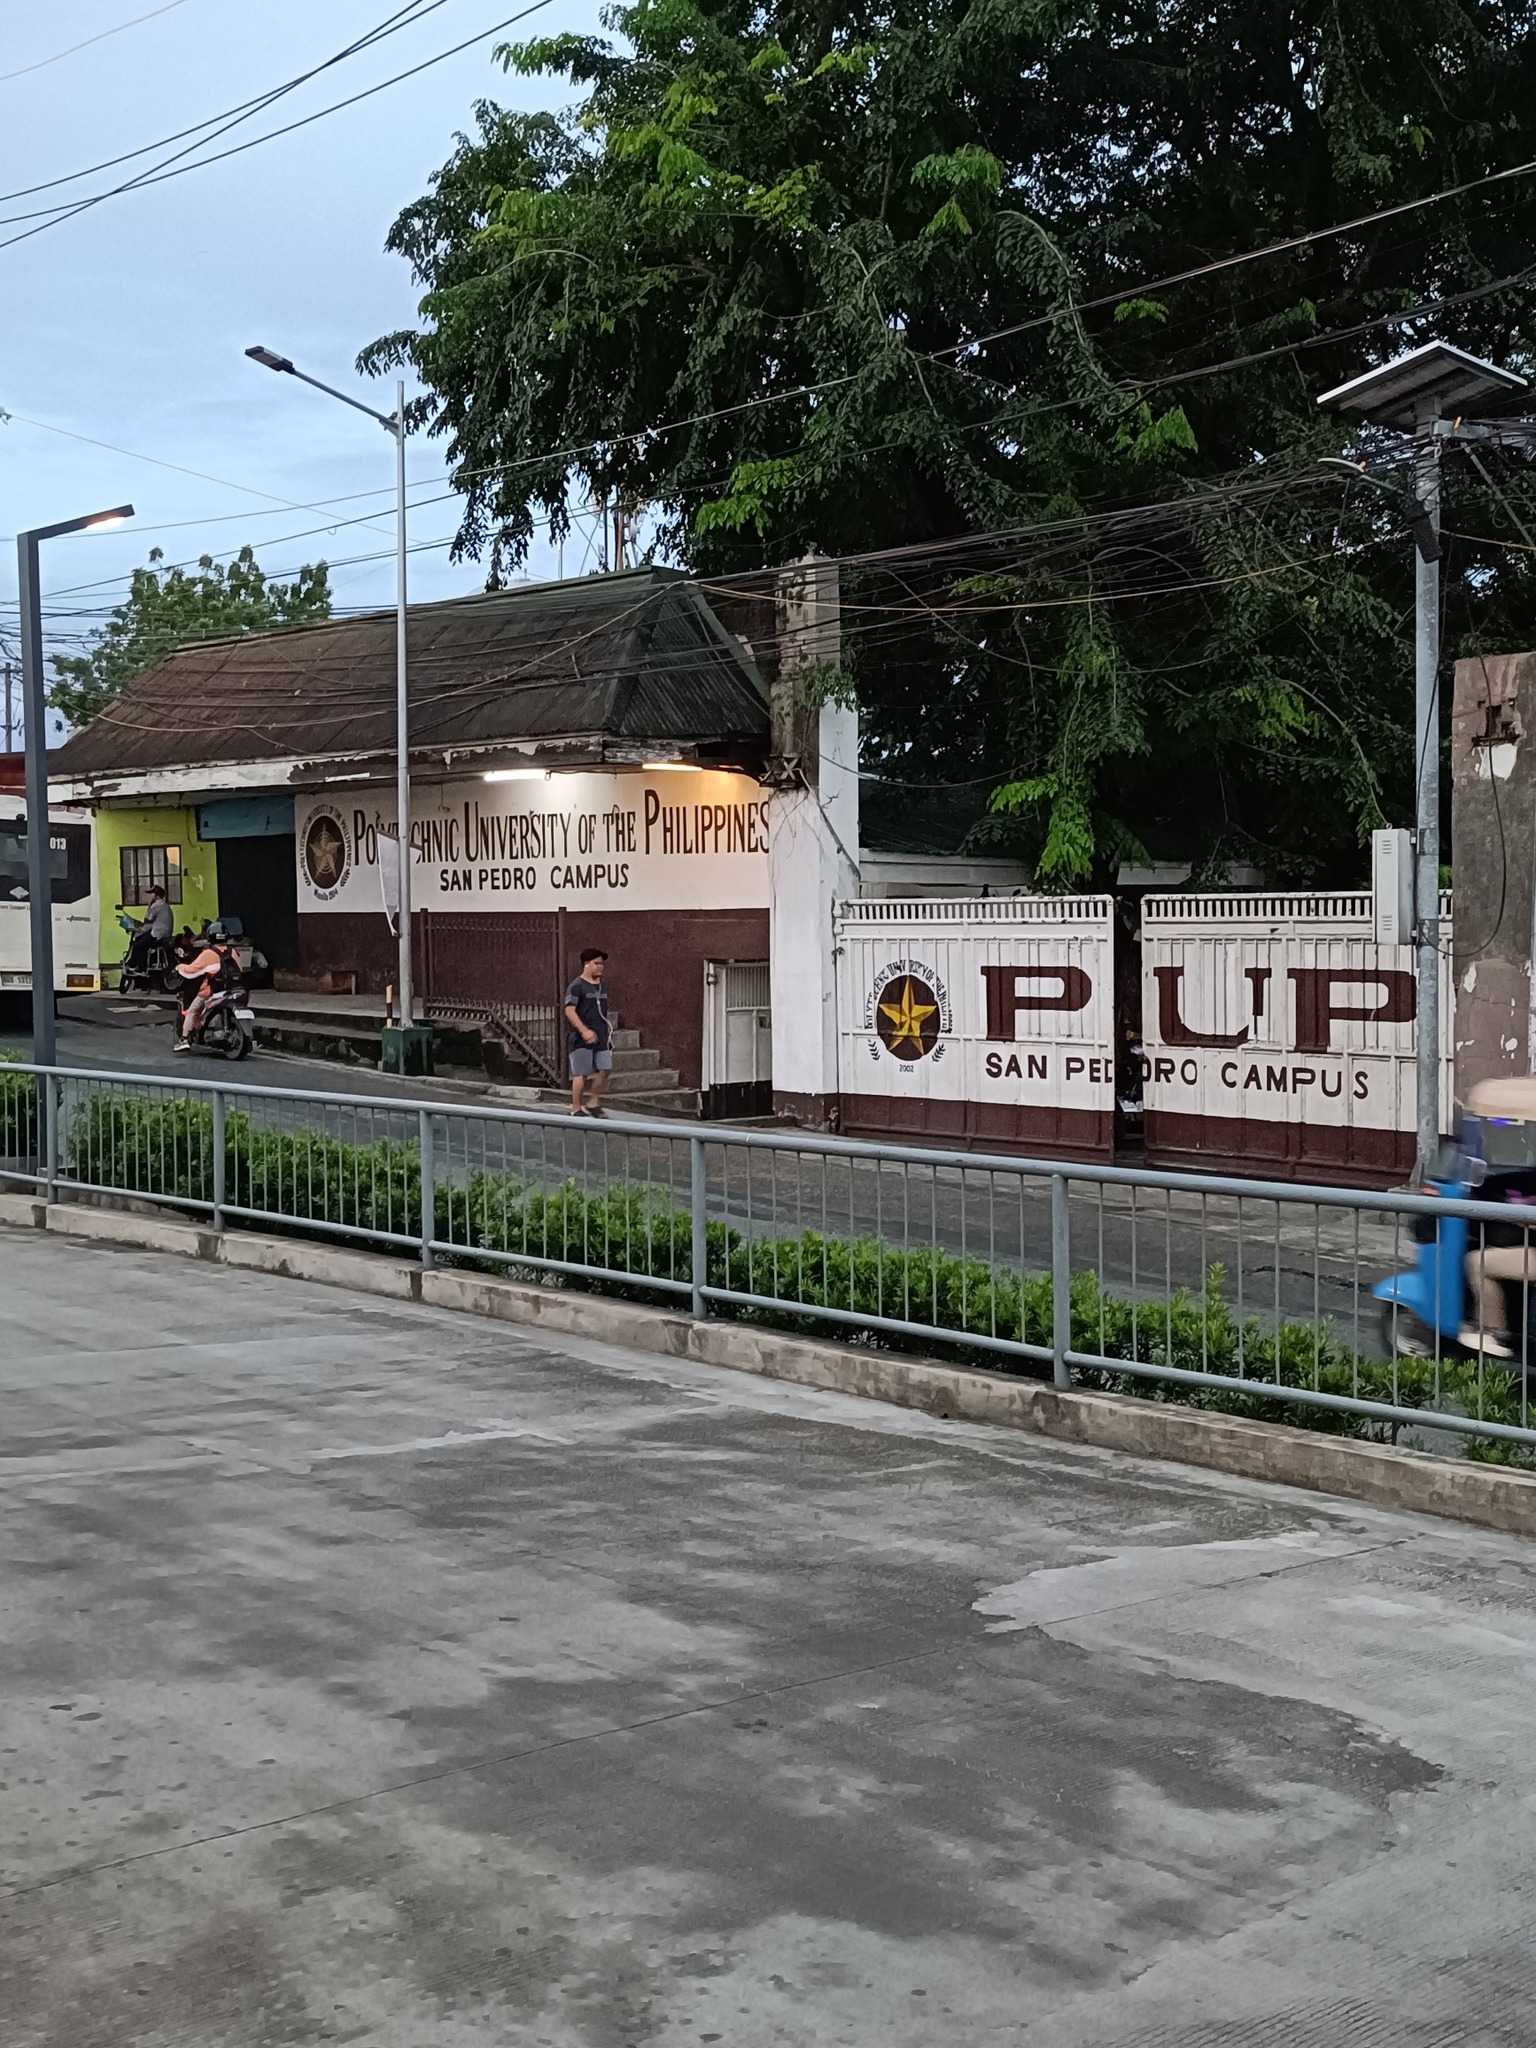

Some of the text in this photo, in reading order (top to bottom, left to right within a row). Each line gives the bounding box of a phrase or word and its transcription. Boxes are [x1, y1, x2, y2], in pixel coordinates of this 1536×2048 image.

[464, 801, 571, 861] UNIVERSITY
[578, 814, 596, 854] OF
[603, 811, 636, 852] THE
[645, 789, 769, 855] PHILIPPINES
[440, 863, 629, 891] SAN PEDRO CAMPUS
[899, 1064, 914, 1073] 2002
[985, 1052, 1047, 1079] SAN
[1221, 1061, 1369, 1100] CAMPUS
